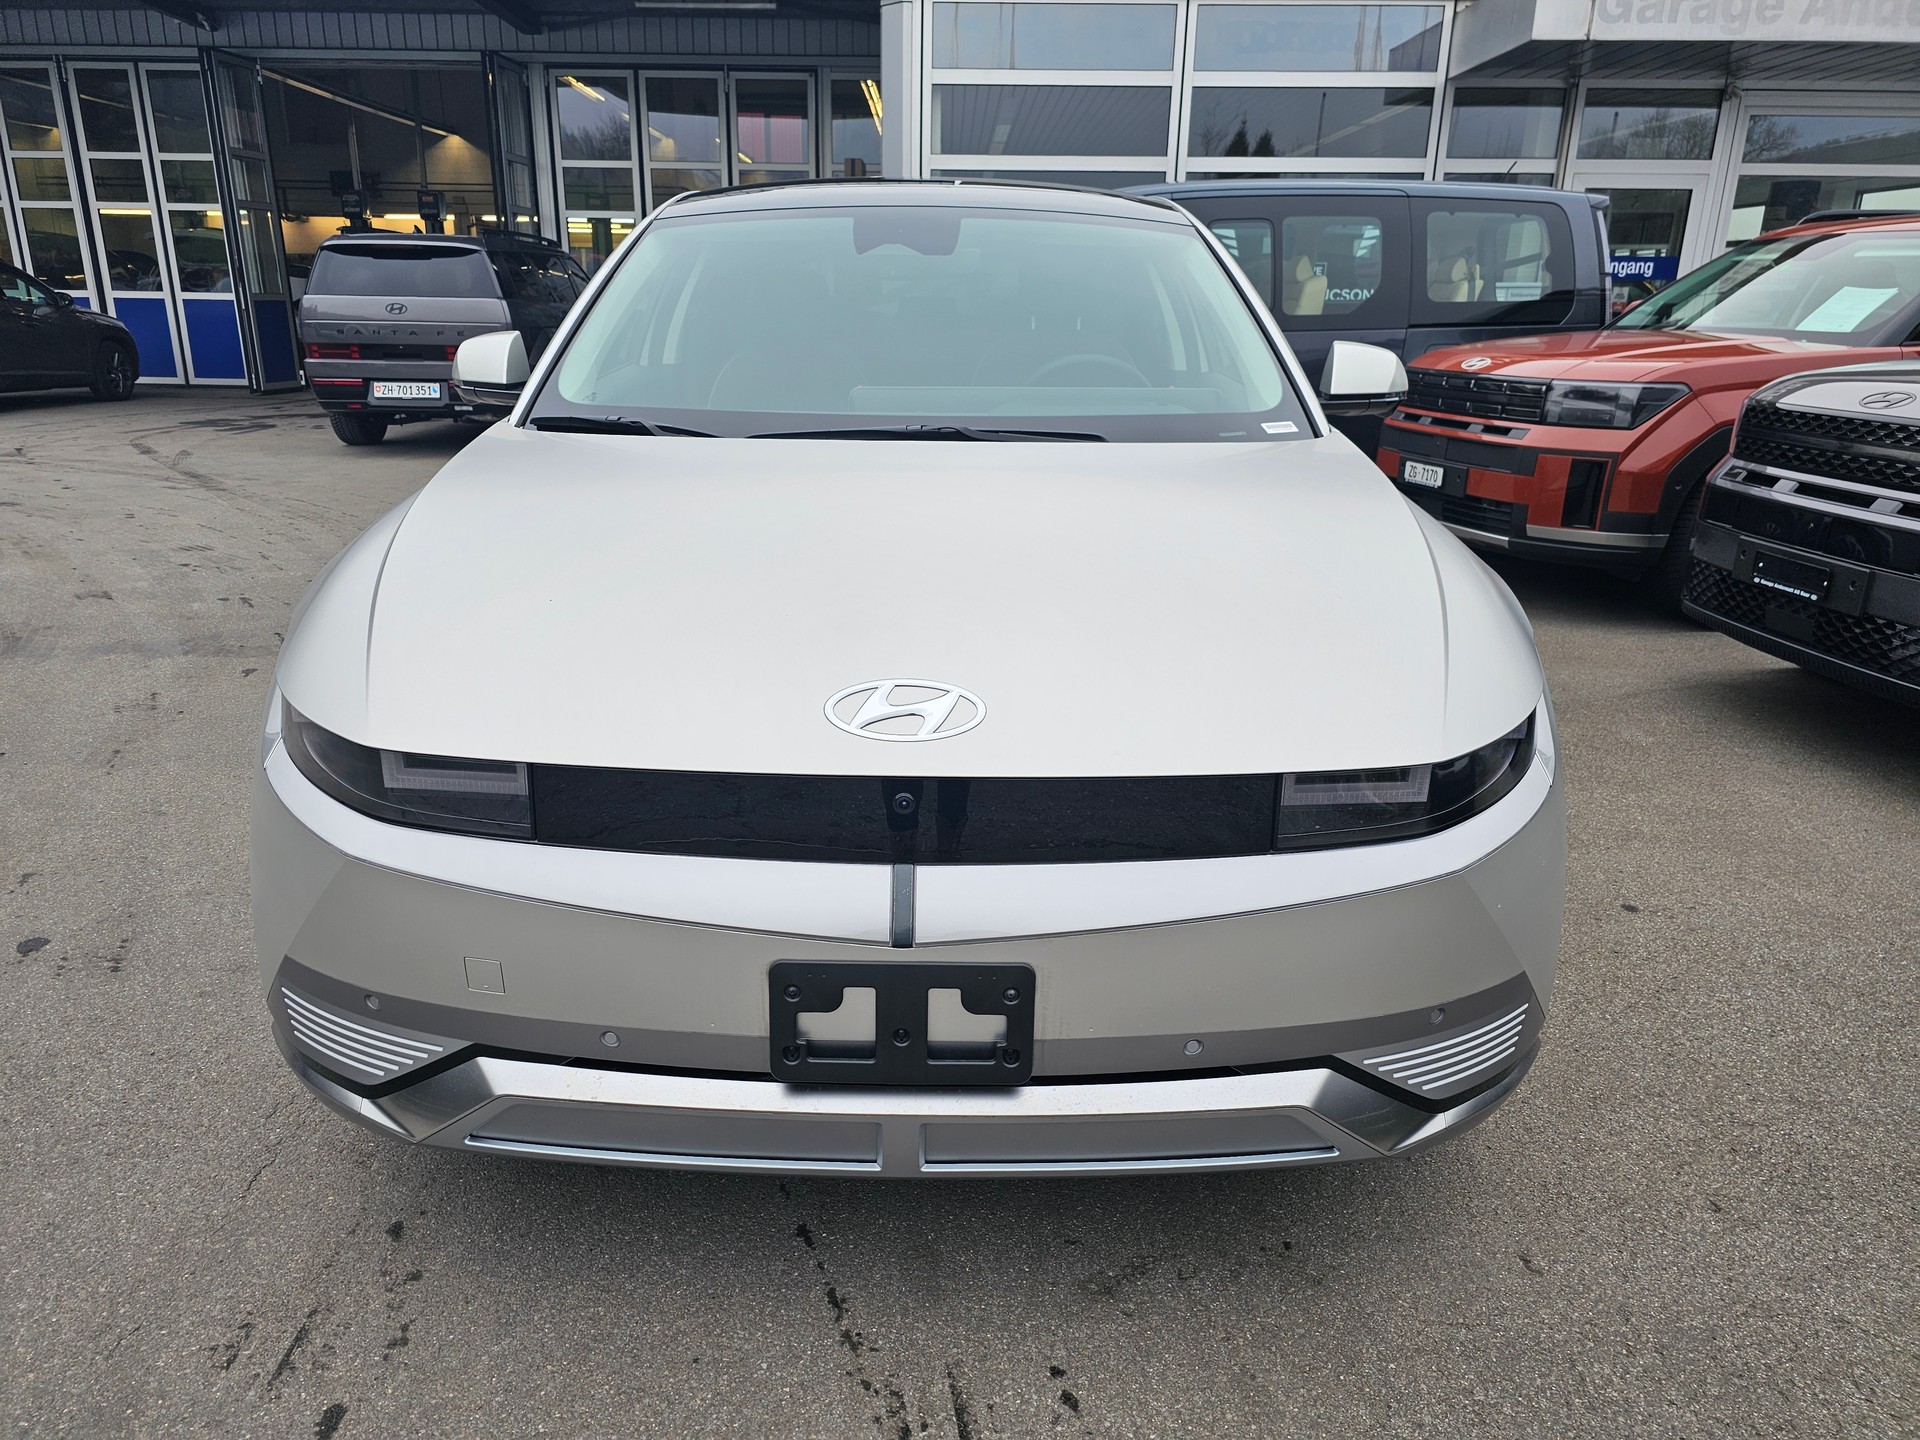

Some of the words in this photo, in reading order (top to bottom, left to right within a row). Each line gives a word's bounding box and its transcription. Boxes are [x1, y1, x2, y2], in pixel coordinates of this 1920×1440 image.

[1598, 0, 1785, 35] Garage
[1610, 261, 1654, 278] ngang
[336, 328, 419, 337] SANTA
